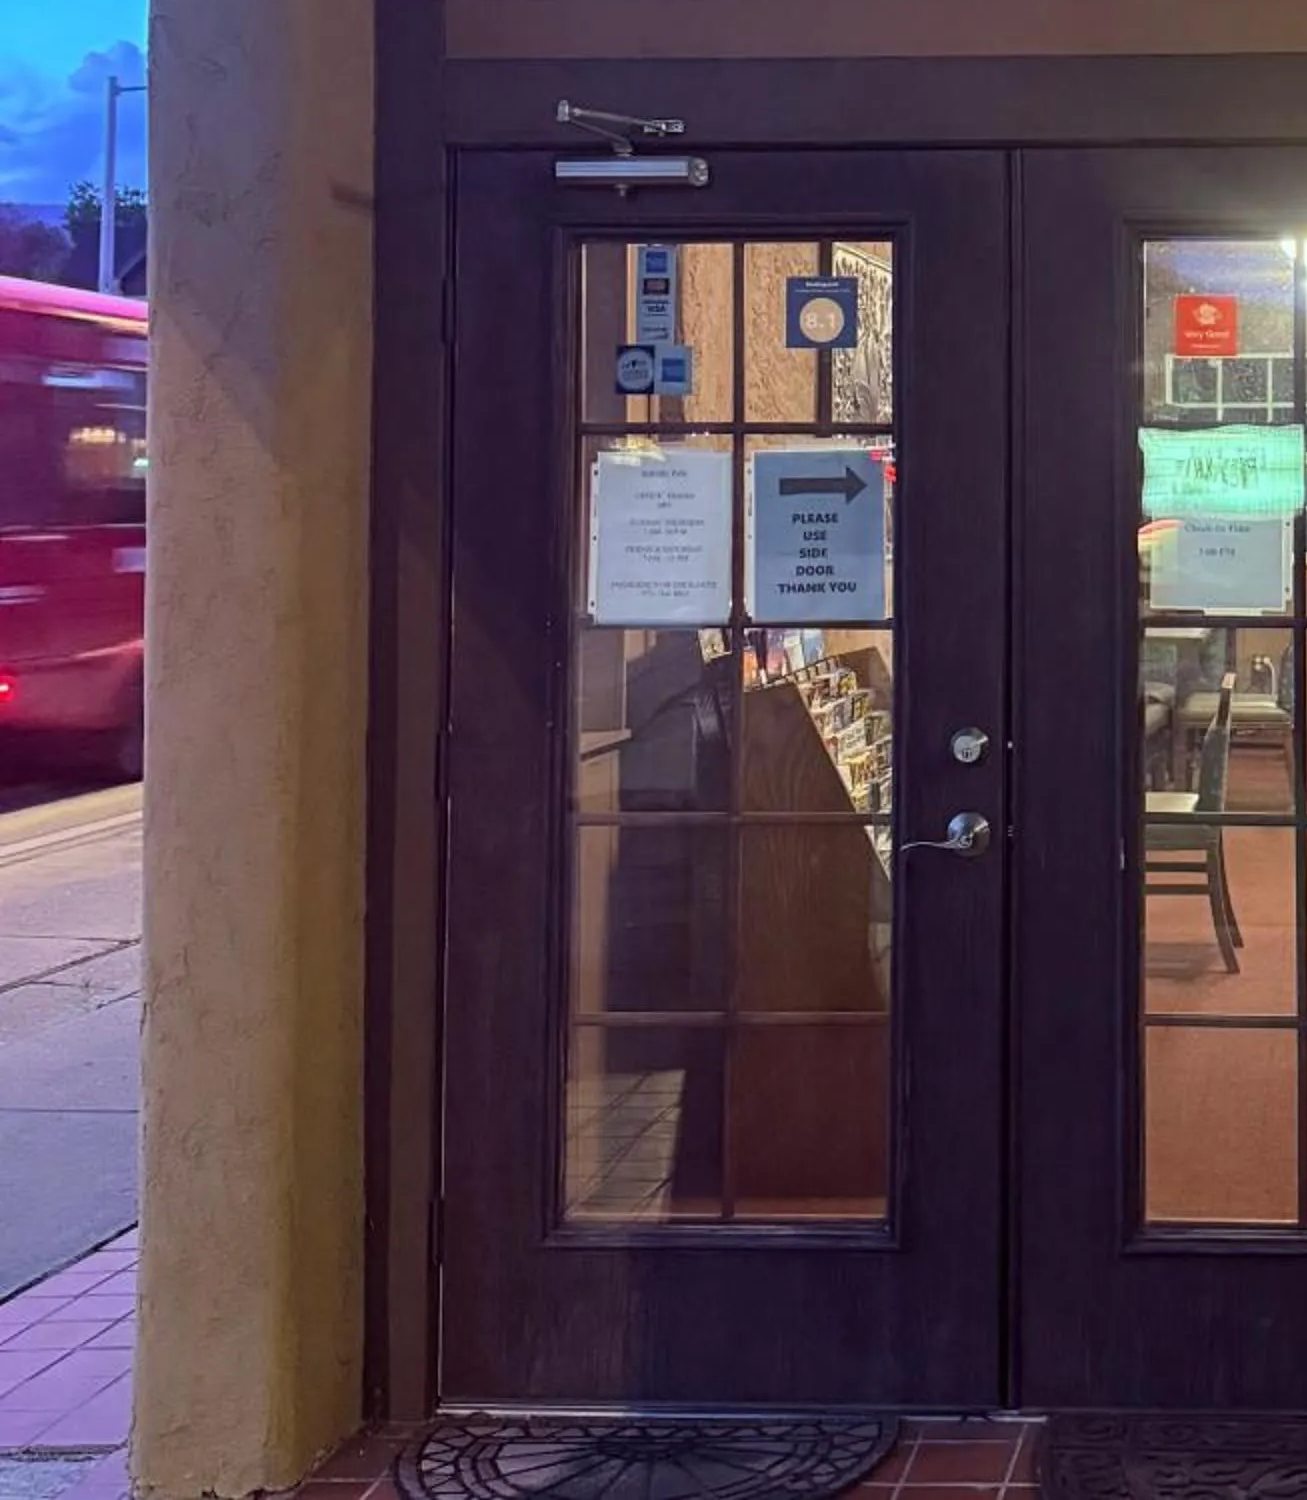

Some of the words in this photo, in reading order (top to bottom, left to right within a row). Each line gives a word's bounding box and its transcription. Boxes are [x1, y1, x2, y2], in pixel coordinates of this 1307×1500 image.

[792, 512, 839, 524] PLEASE
[803, 530, 827, 541] USE
[799, 547, 828, 559] SIDE
[796, 565, 834, 576] DOOR
[777, 583, 826, 593] THANK
[829, 582, 857, 593] YOU
